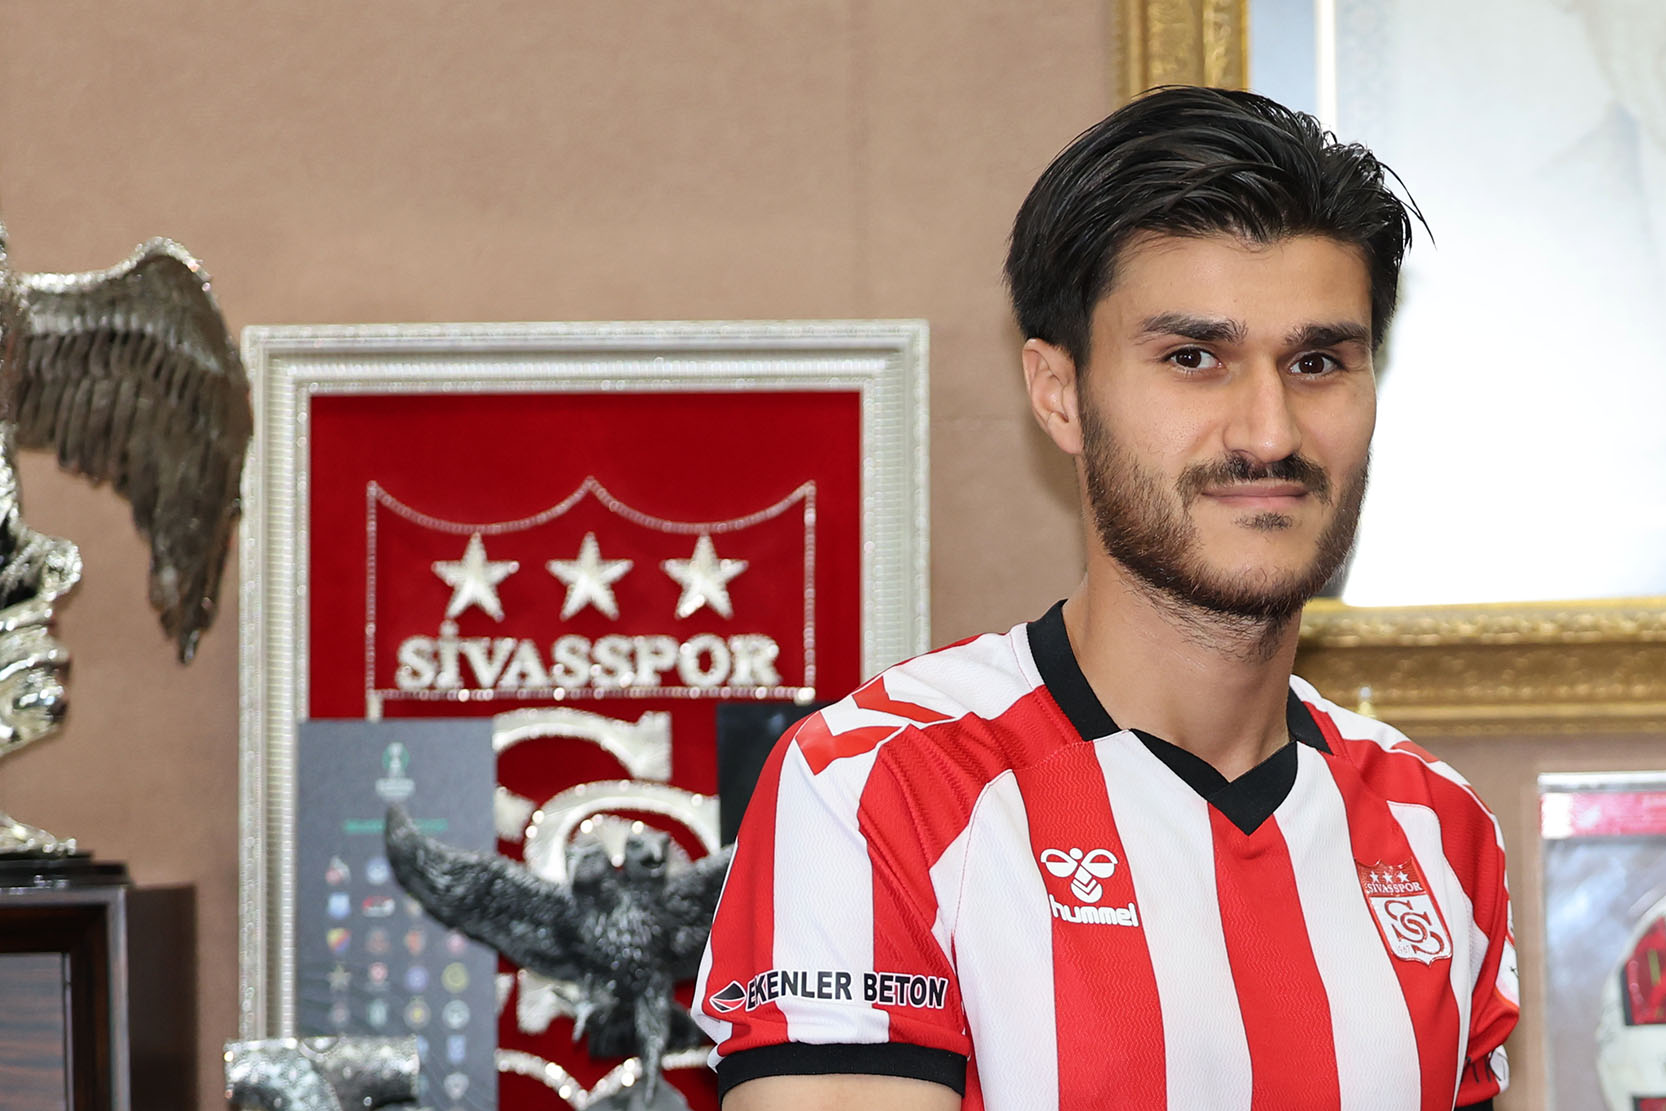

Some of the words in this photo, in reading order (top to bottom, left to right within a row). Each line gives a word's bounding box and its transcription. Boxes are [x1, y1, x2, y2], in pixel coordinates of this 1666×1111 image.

[396, 619, 783, 689] SİVASSPOR
[1049, 894, 1139, 927] hummel
[863, 973, 947, 1009] BETON
